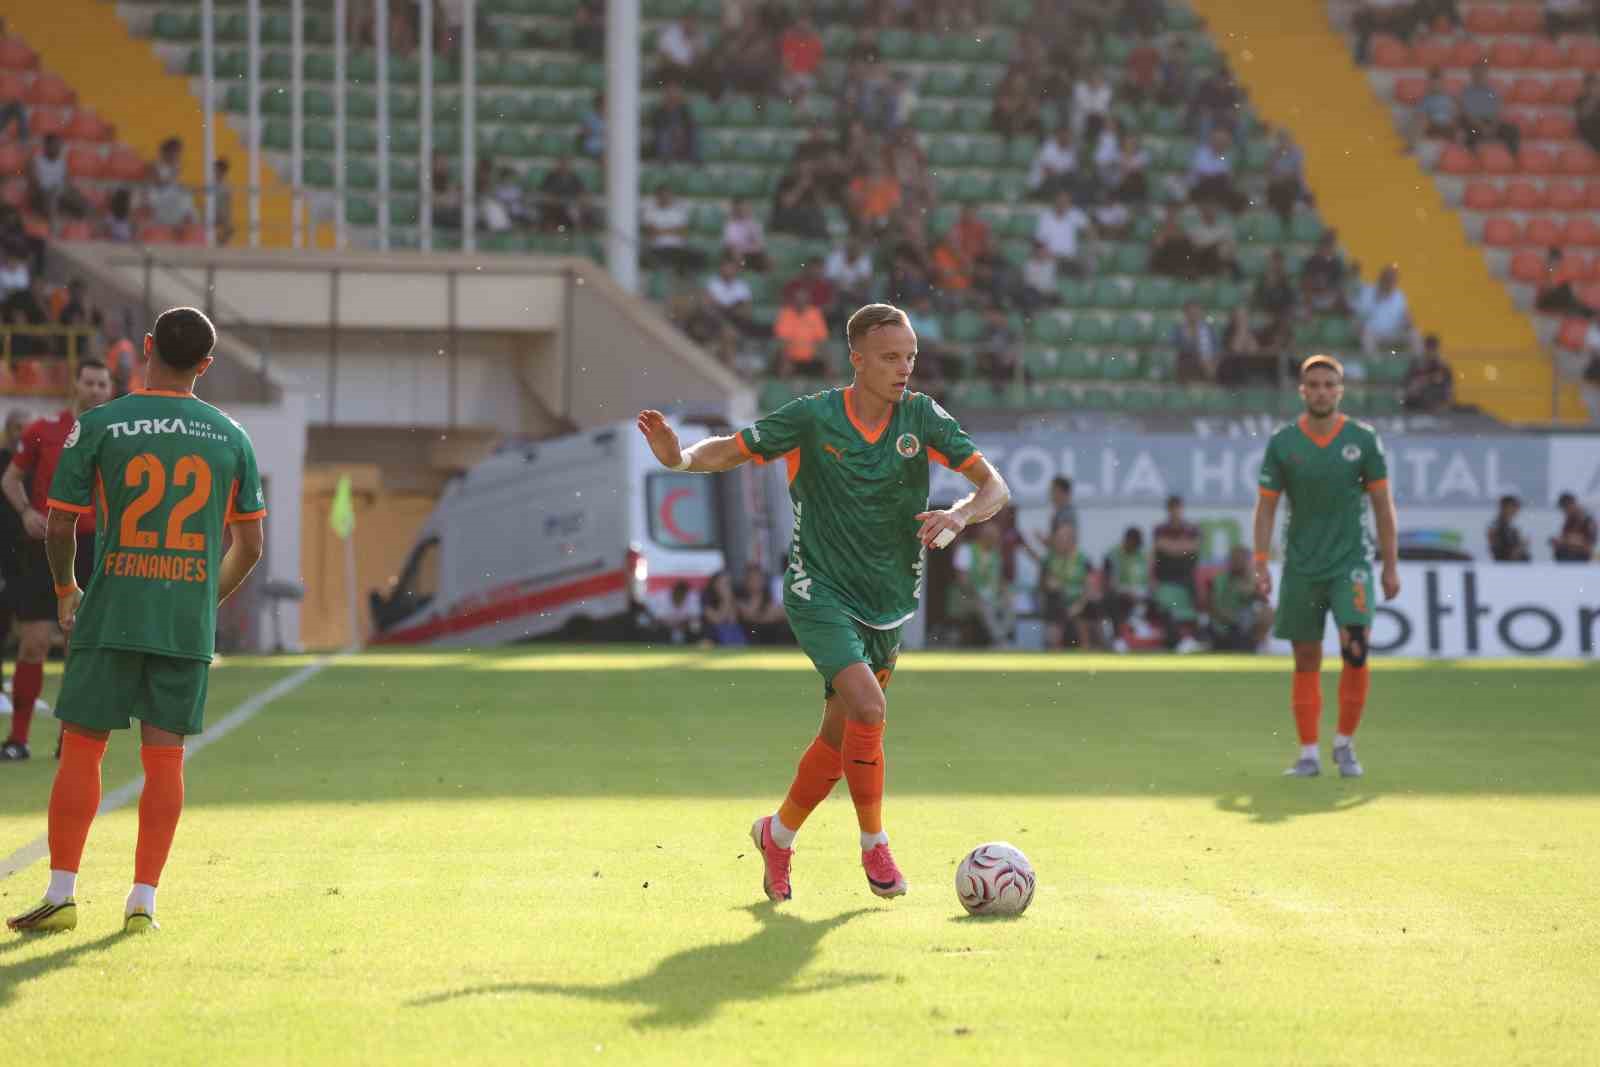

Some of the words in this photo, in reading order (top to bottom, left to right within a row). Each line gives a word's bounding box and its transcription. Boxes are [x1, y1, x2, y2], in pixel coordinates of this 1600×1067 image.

[107, 418, 187, 438] TURKA
[120, 453, 212, 551] 22
[104, 552, 207, 583] FERNANDES
